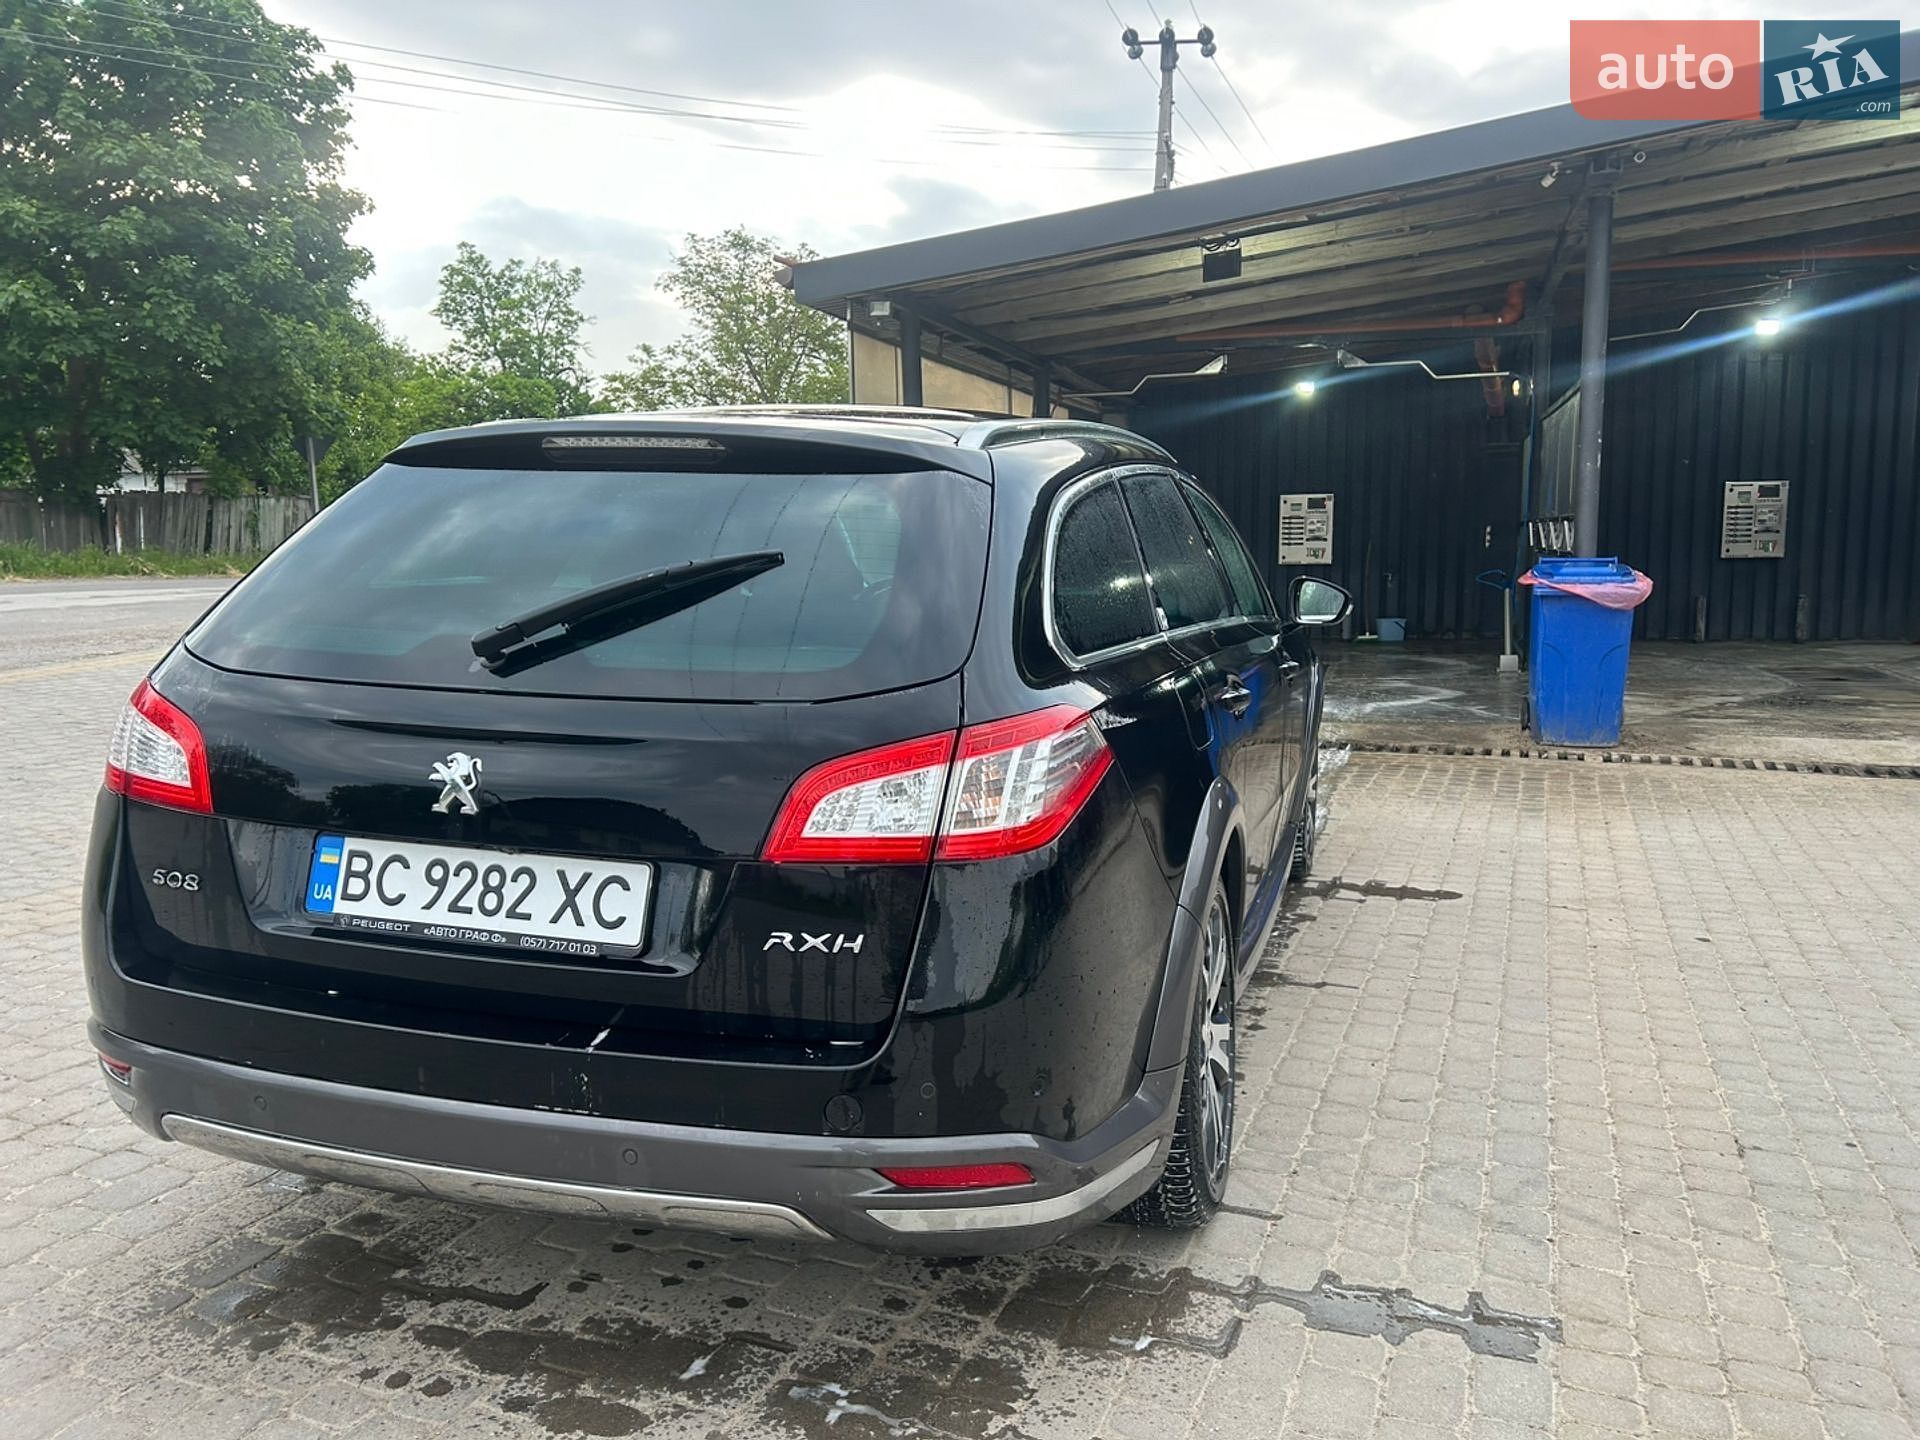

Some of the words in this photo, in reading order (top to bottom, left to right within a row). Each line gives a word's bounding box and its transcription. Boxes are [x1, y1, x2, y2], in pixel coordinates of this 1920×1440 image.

[152, 868, 200, 891] 508
[313, 883, 333, 900] UA
[340, 849, 411, 907] BC
[421, 857, 538, 922] 9282
[548, 869, 631, 931] XC
[352, 918, 411, 932] PEUGEOT
[520, 936, 547, 950] (057)
[548, 940, 568, 951] 717
[762, 932, 865, 954] RXH
